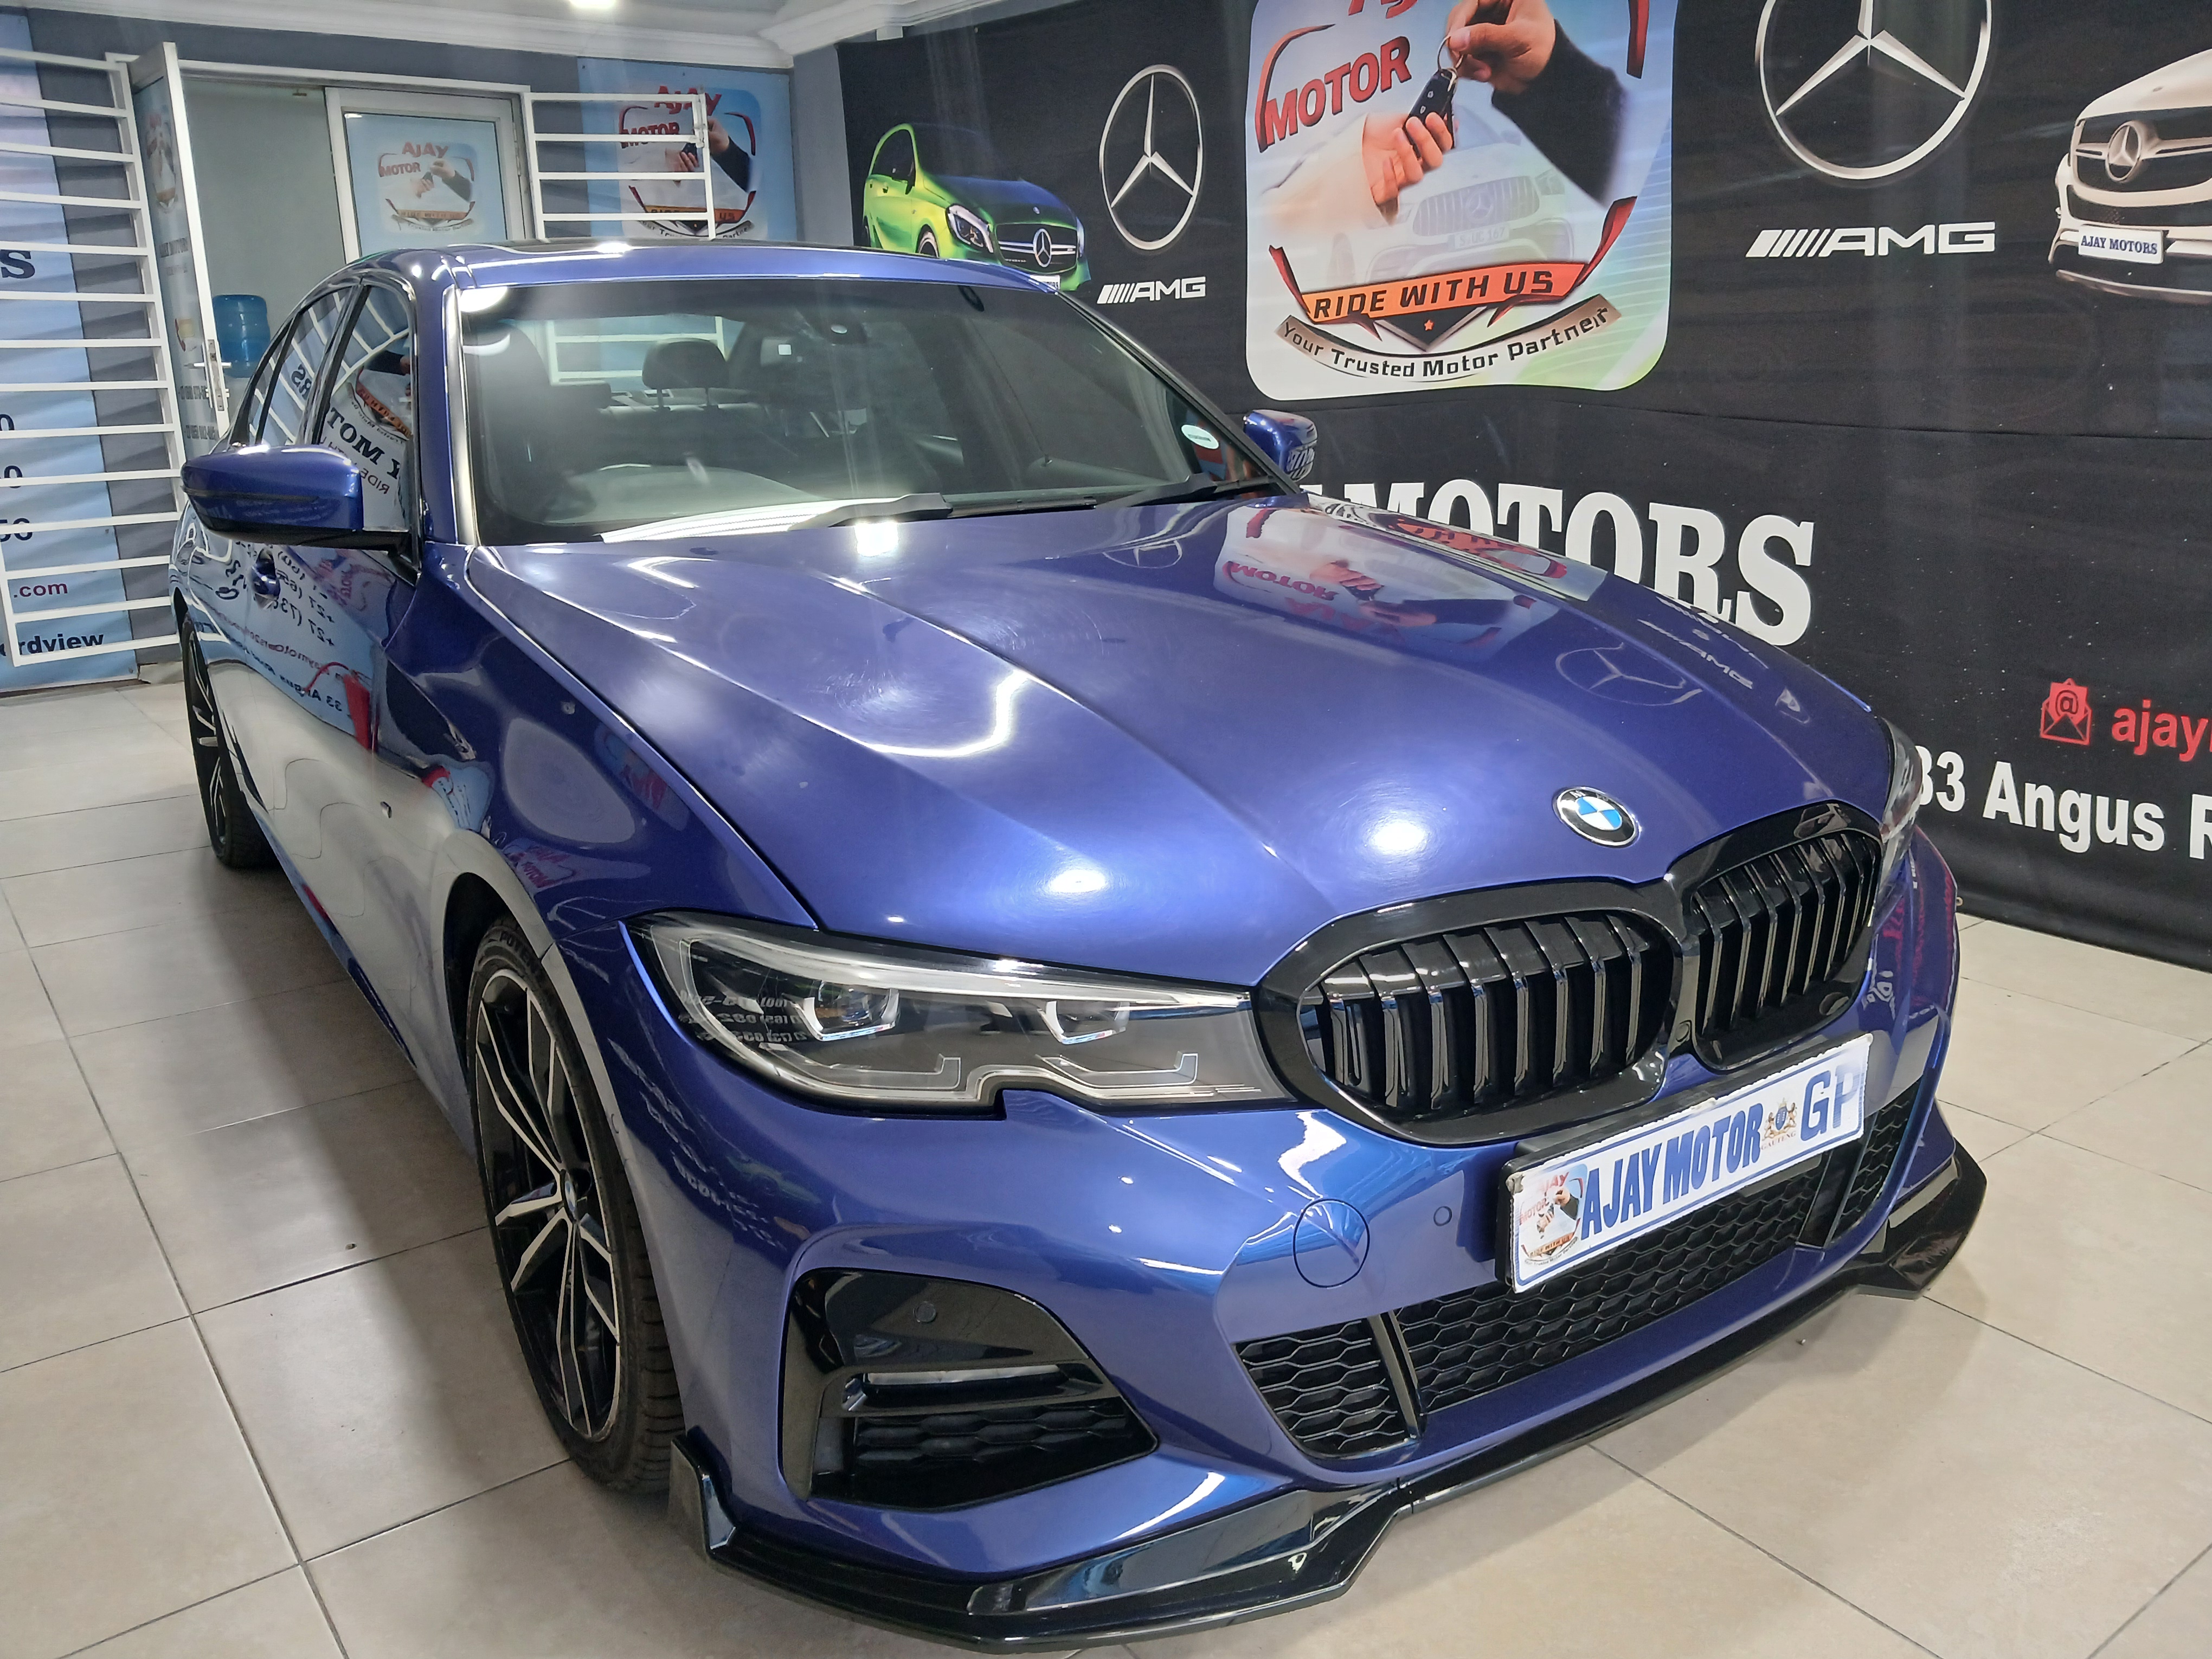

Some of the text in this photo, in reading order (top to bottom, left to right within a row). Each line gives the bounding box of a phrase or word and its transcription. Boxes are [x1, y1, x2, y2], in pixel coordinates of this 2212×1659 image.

[1265, 36, 1412, 147] MOTOR
[380, 162, 421, 177] MOTOR
[402, 136, 449, 158] AJAY
[2080, 235, 2158, 255] AJAY MOTORS
[1314, 271, 1554, 319] RIDE WITH US
[1282, 306, 1610, 378] Your Trusted Motor Partner
[2111, 699, 2212, 762] ajay
[1982, 761, 2165, 853] Angus
[1580, 1064, 1860, 1240] AJAY MOTOR GP
